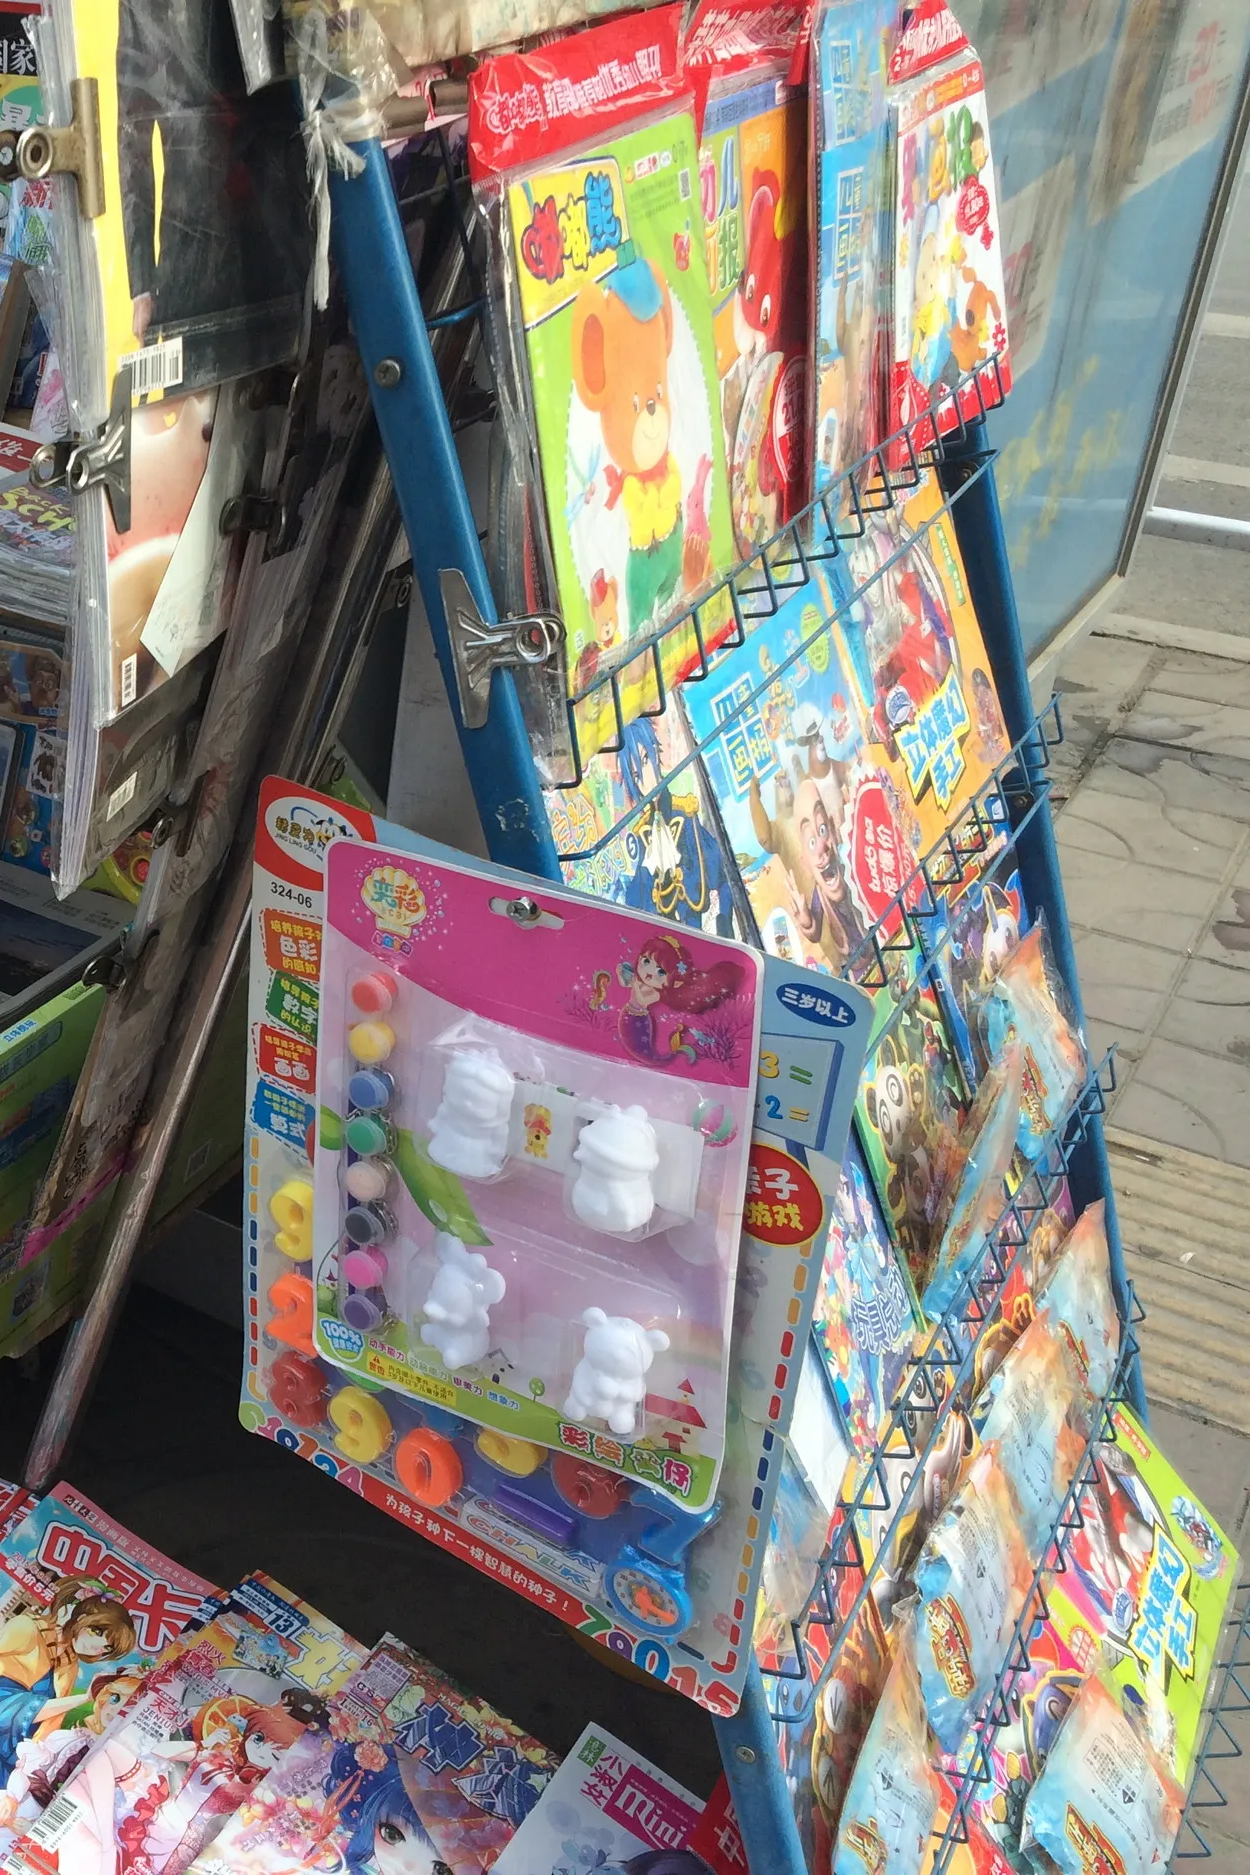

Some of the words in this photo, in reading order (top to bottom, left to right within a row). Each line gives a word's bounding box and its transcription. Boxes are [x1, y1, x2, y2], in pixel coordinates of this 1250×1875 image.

[898, 666, 970, 787] 立体魔幻
[929, 737, 965, 800] 手工
[270, 881, 314, 908] 324-06
[279, 935, 318, 962] 色彩
[282, 957, 318, 976] 的感知
[781, 985, 851, 1025] 三岁以上
[487, 1389, 521, 1411] 想象力
[267, 1610, 296, 1636] 13
[1130, 1531, 1186, 1672] 立体魔幻
[1162, 1605, 1196, 1679] 手工
[580, 1755, 625, 1807] 小淑女
[614, 1784, 687, 1850] mini
